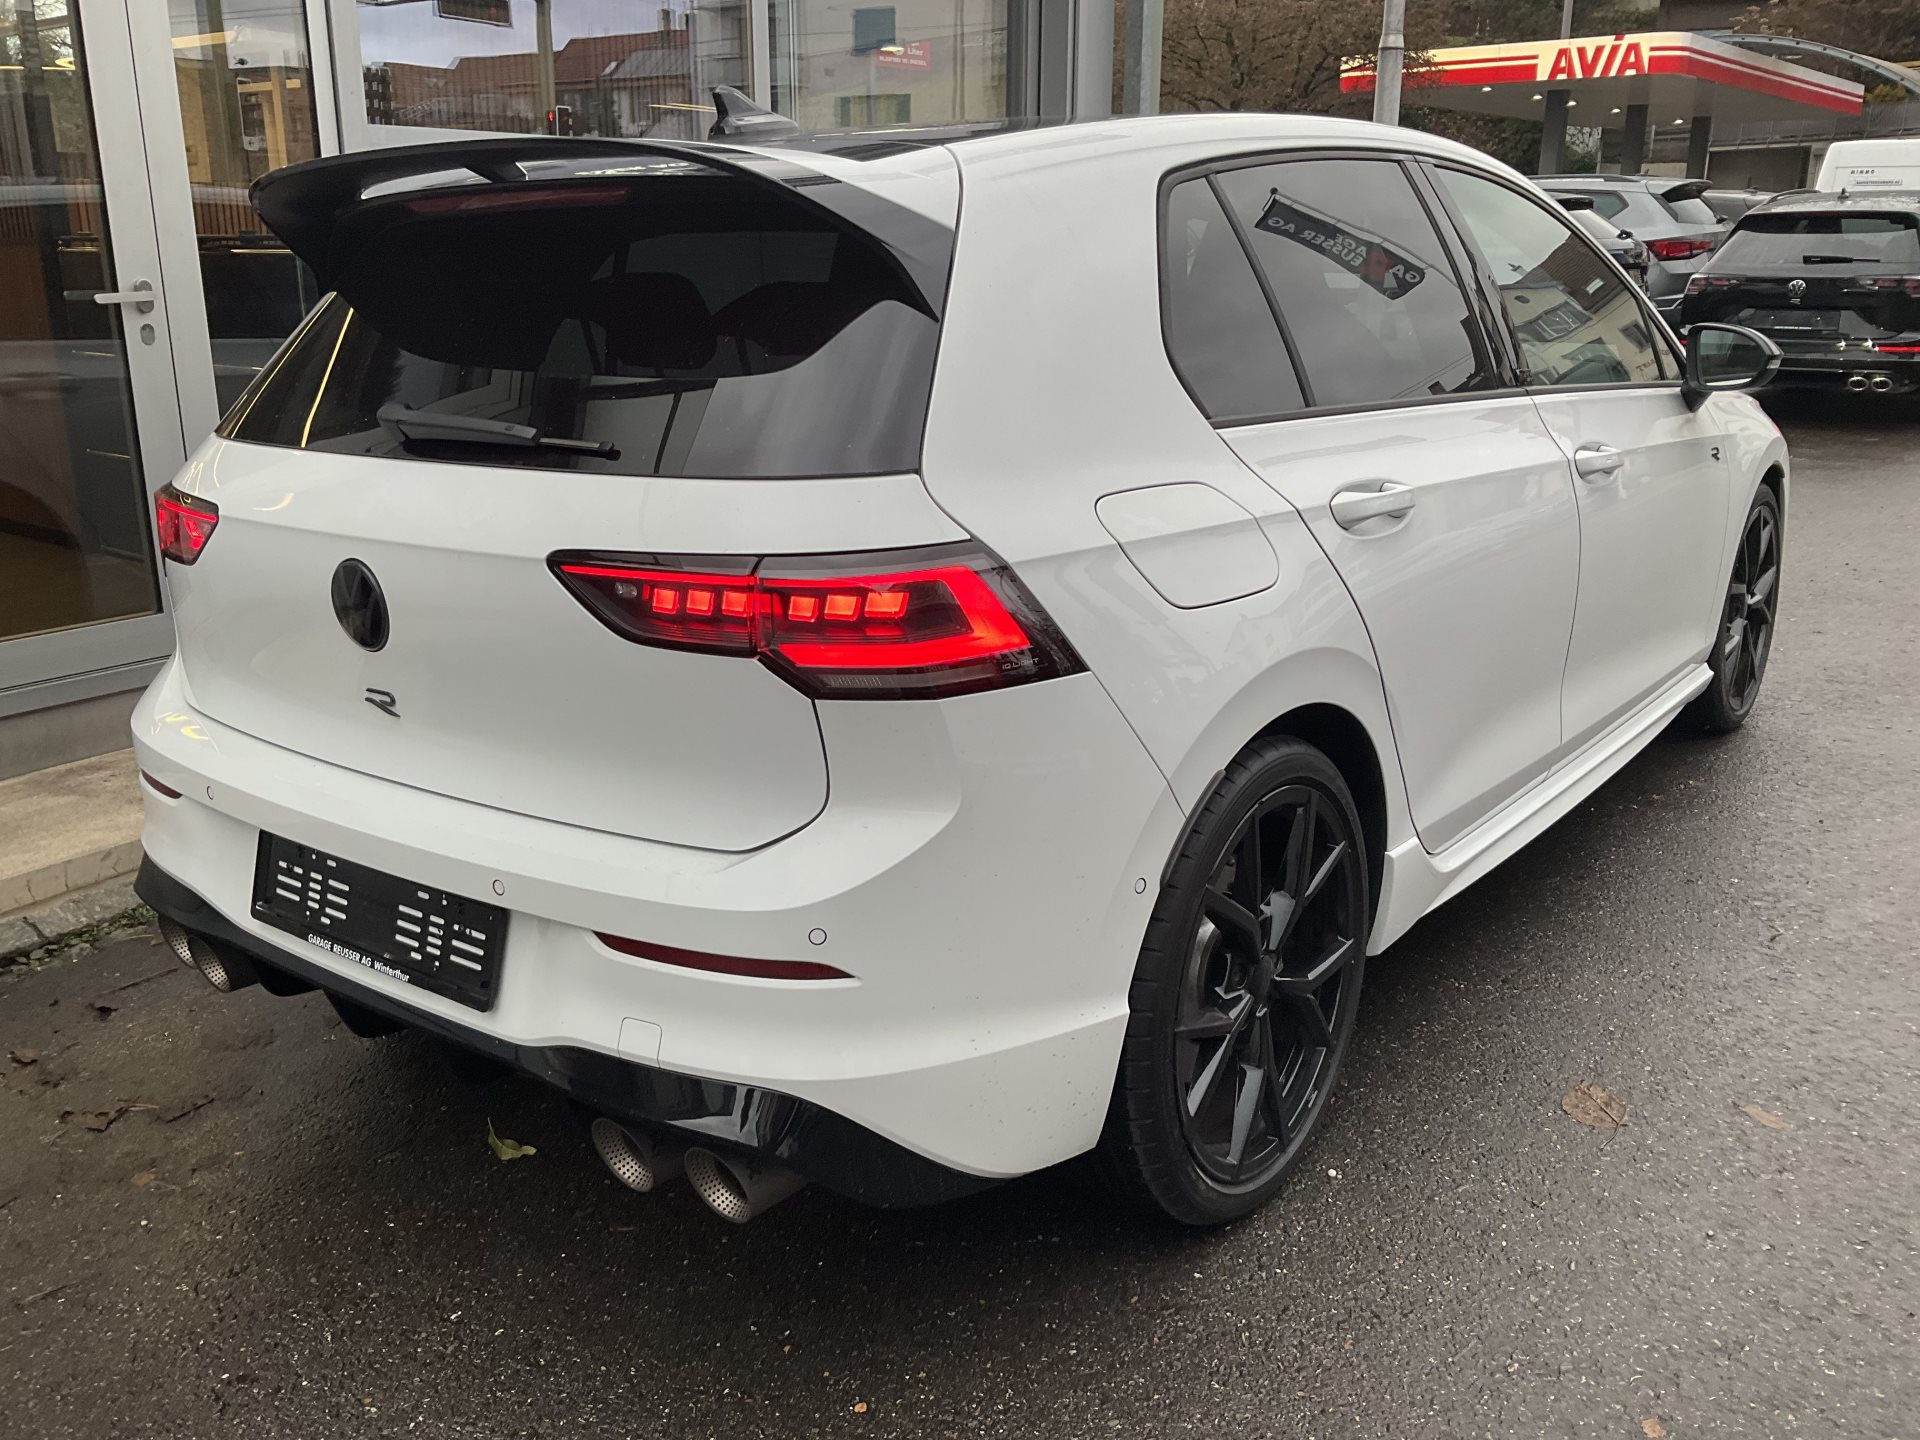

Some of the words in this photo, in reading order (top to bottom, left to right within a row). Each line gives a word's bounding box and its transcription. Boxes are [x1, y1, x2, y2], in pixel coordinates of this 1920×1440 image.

[1547, 33, 1647, 80] AVIA
[365, 687, 401, 718] R
[308, 933, 332, 951] GARAGE
[333, 943, 361, 963] REUSSER
[361, 955, 372, 967] AG
[374, 960, 410, 982] Winterthur
